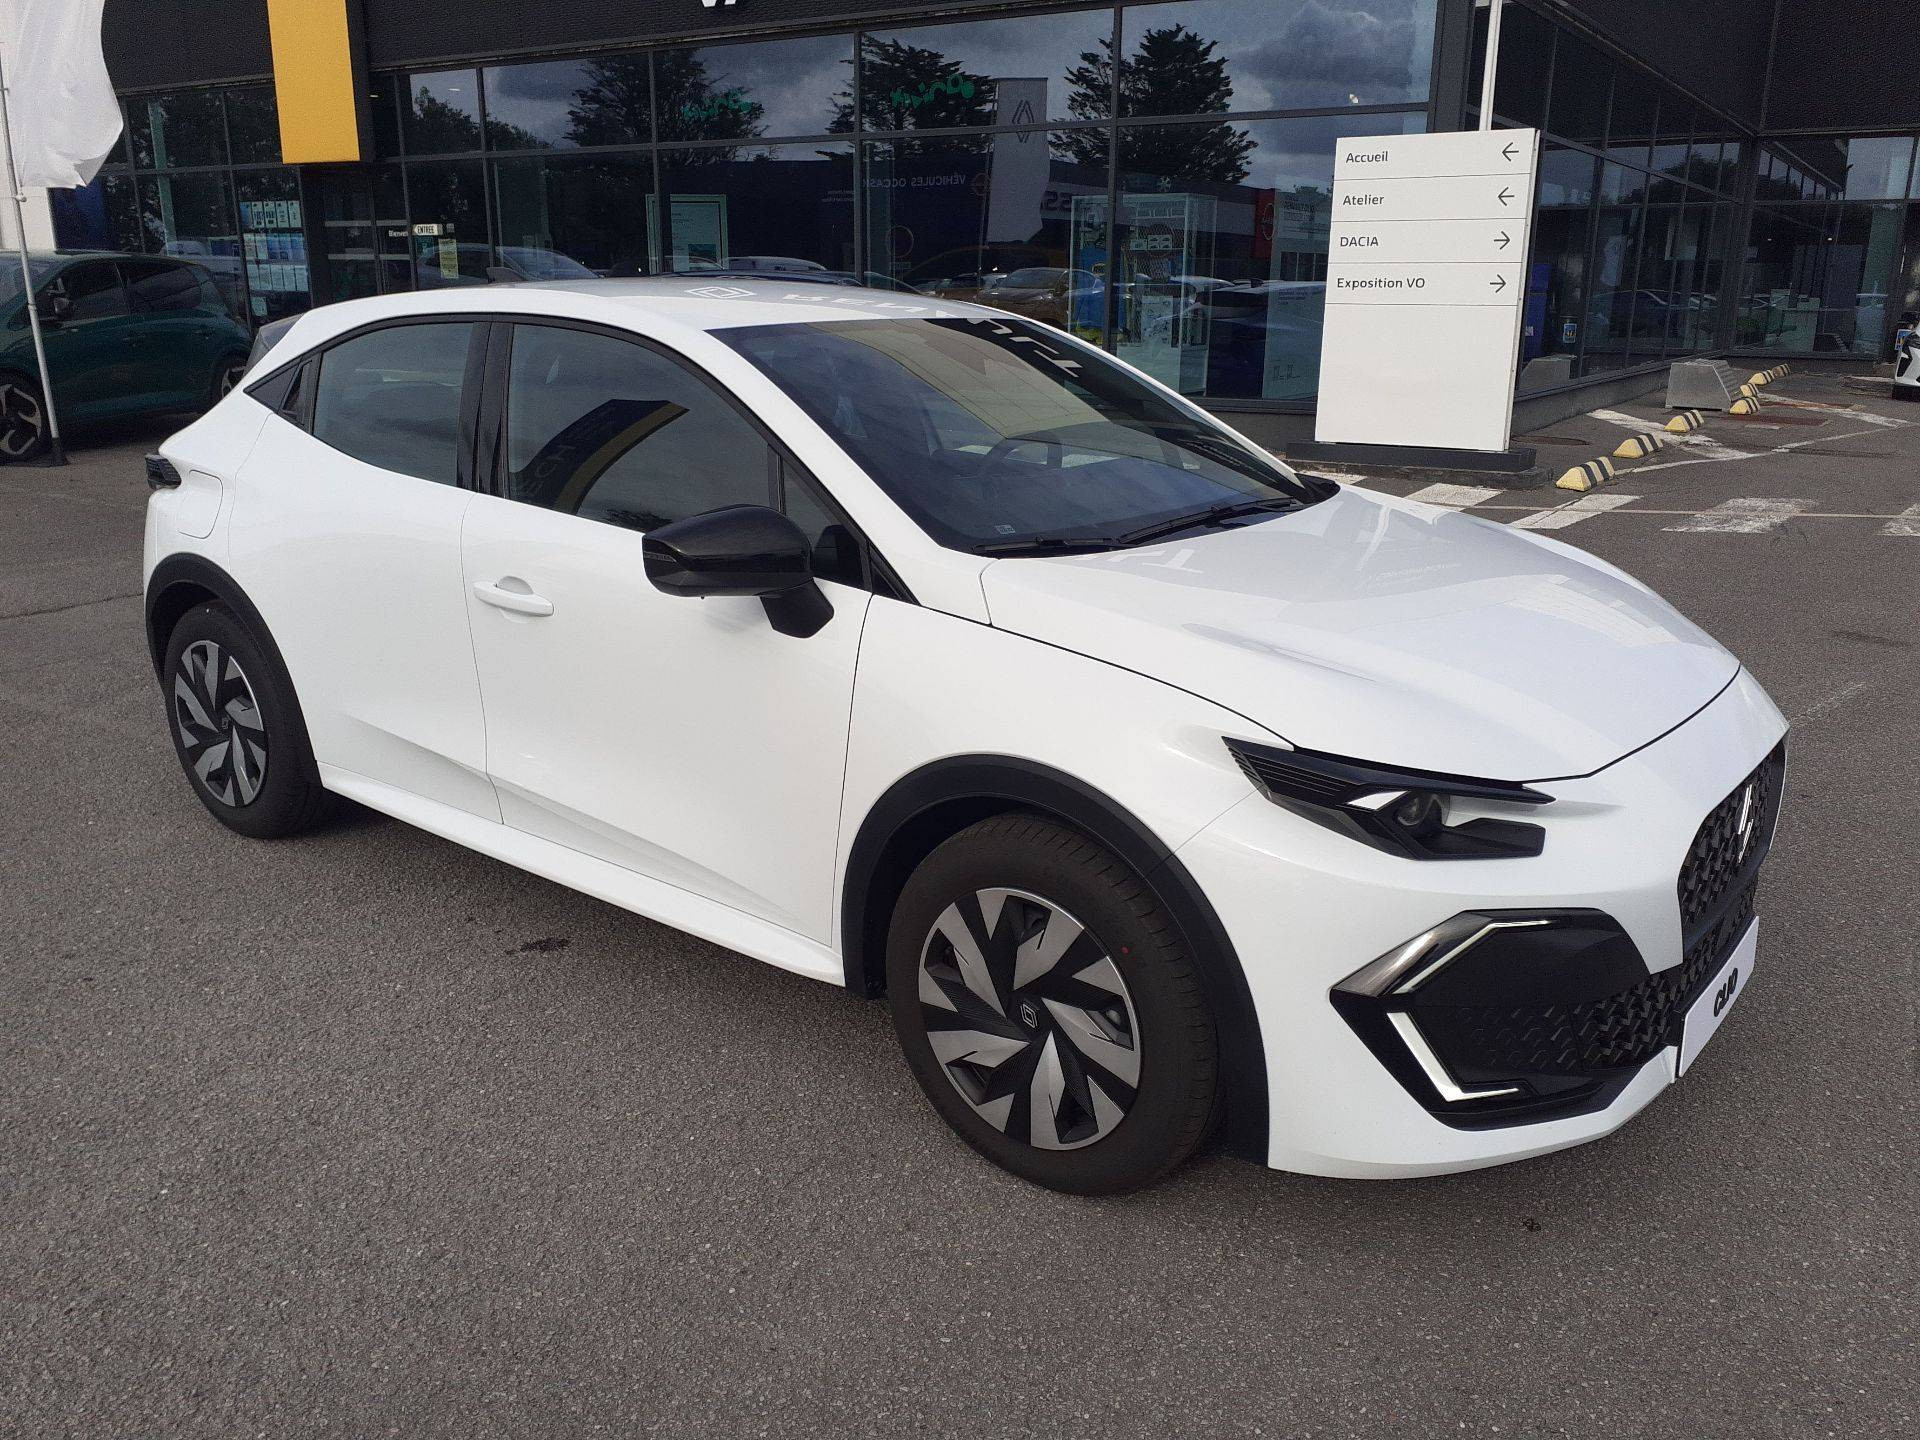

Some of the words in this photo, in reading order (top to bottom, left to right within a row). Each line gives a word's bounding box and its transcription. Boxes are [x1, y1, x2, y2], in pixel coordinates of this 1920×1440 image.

[1345, 151, 1389, 163] Accueil
[1342, 194, 1385, 206] Atelier
[1340, 236, 1379, 247] DACIA
[1337, 277, 1403, 291] Exposition
[1406, 277, 1426, 289] VO
